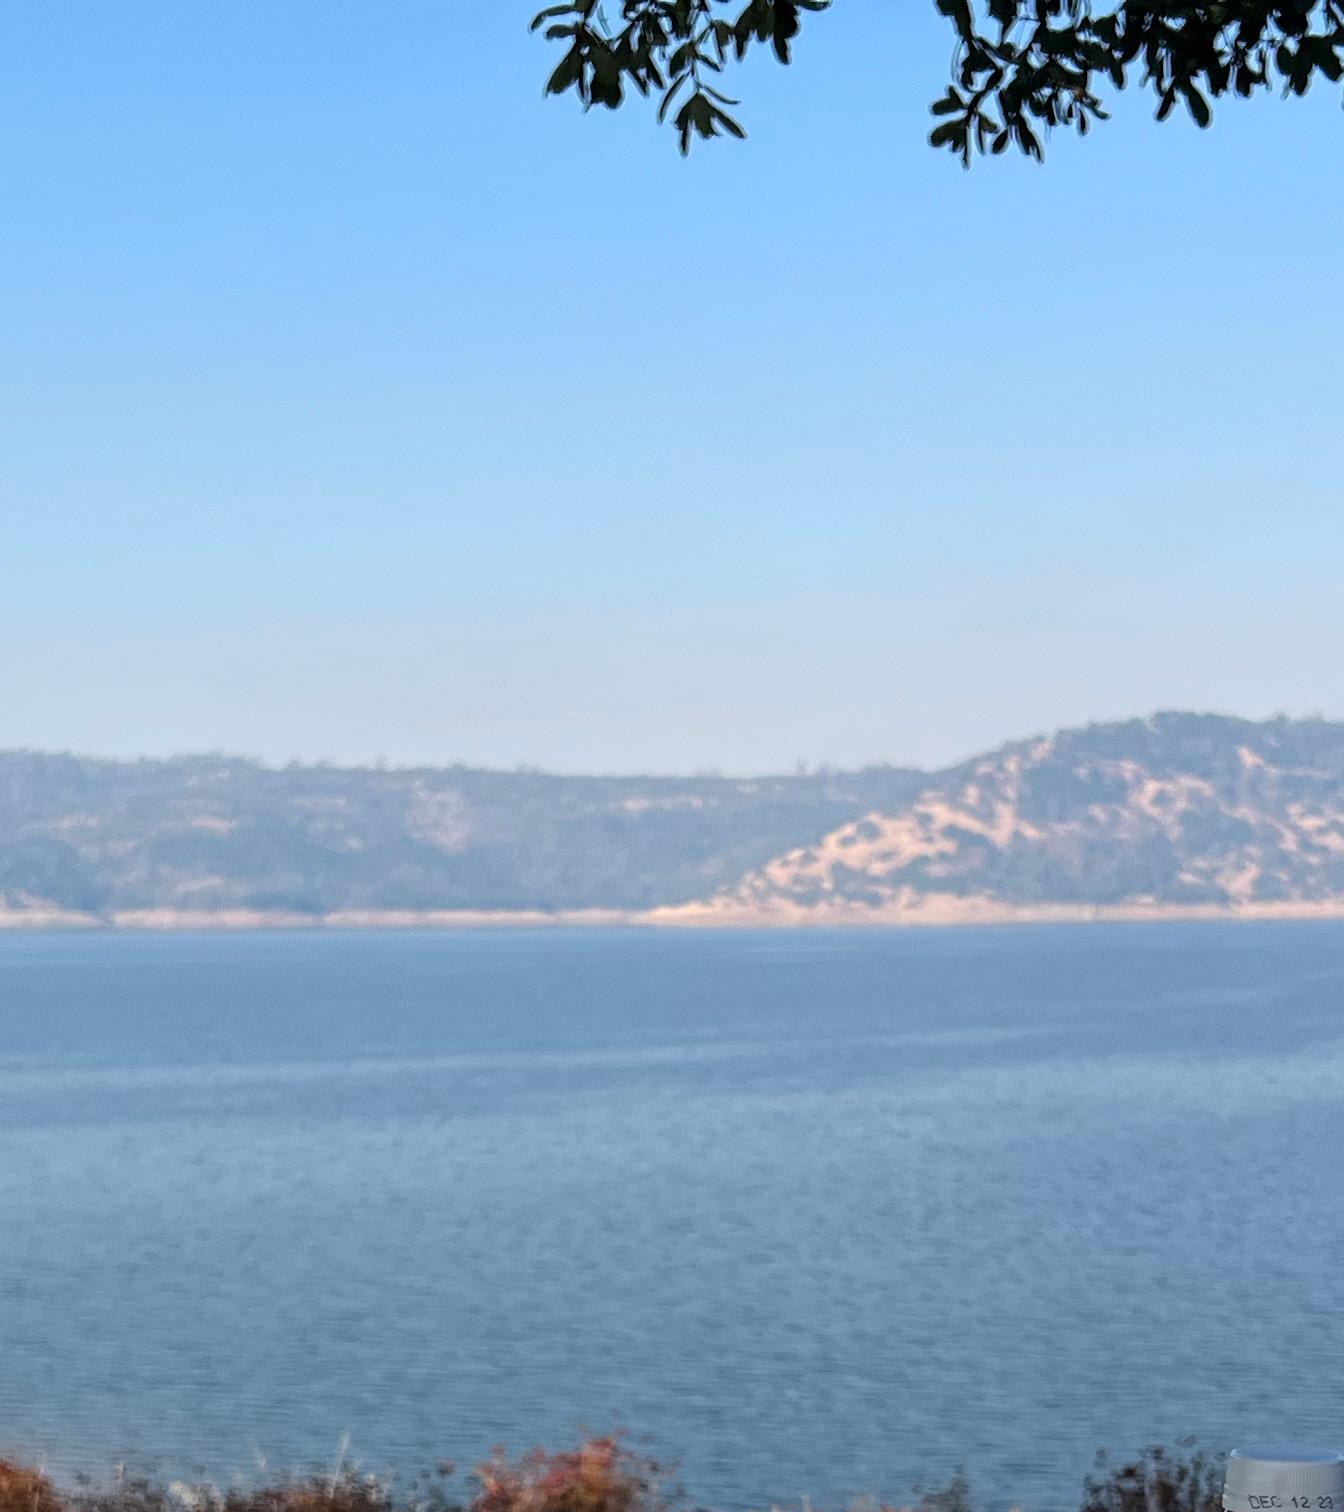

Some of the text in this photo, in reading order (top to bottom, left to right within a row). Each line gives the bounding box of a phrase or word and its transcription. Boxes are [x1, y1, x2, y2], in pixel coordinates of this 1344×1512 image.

[1247, 1495, 1335, 1510] DEC 12 23
